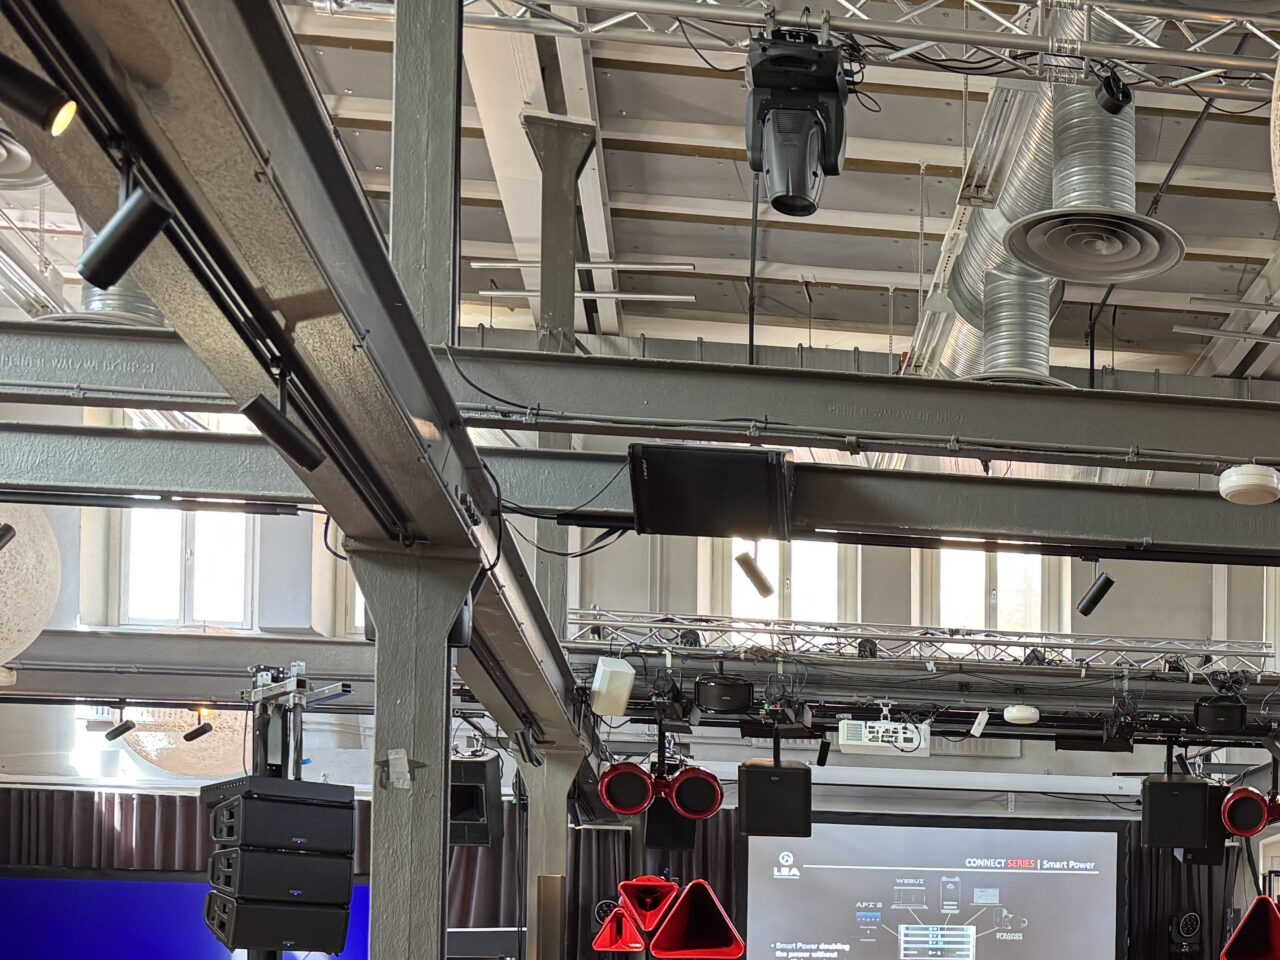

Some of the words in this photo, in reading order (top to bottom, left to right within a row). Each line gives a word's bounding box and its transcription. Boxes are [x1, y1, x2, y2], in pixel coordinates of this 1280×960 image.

[965, 858, 1006, 867] CONNECT
[1007, 859, 1035, 868] SERIES
[1043, 860, 1067, 869] Smart
[1069, 861, 1095, 870] Power
